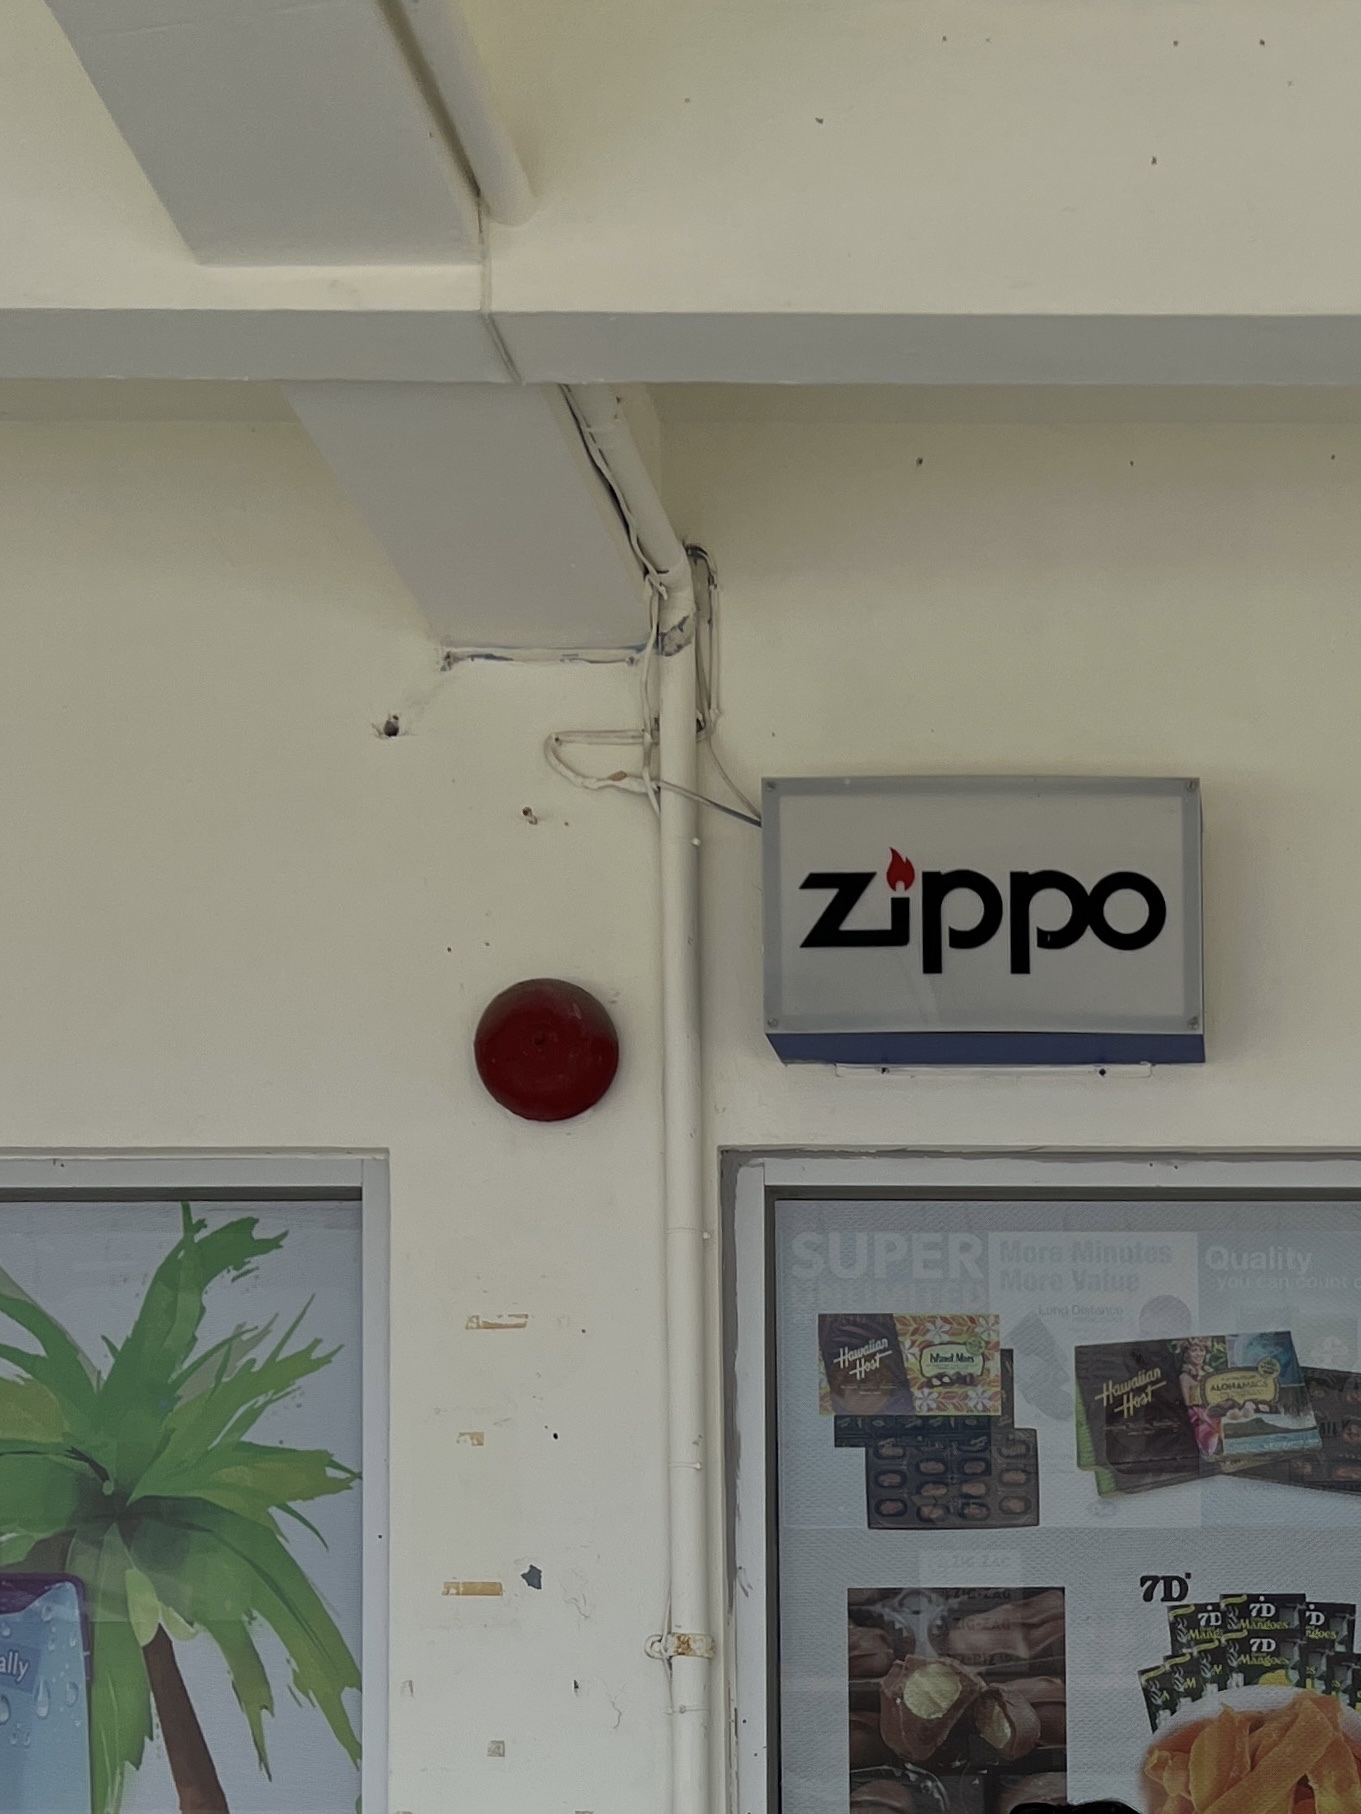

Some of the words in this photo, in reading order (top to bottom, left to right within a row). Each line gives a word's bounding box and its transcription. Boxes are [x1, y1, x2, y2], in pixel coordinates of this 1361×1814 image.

[791, 1231, 985, 1280] SUPER
[1206, 1245, 1313, 1276] Quality
[833, 1337, 889, 1370] Hawaiian
[850, 1350, 893, 1380] Host
[1096, 1366, 1162, 1406] Hawaiian
[1114, 1381, 1167, 1418] Host
[1140, 1574, 1189, 1603] 7D
[1198, 1611, 1222, 1626] 7D
[1239, 1618, 1289, 1631] Mangoes
[1250, 1603, 1276, 1617] 7D
[1250, 1638, 1277, 1651] 7D
[1239, 1654, 1290, 1666] Mangoes
